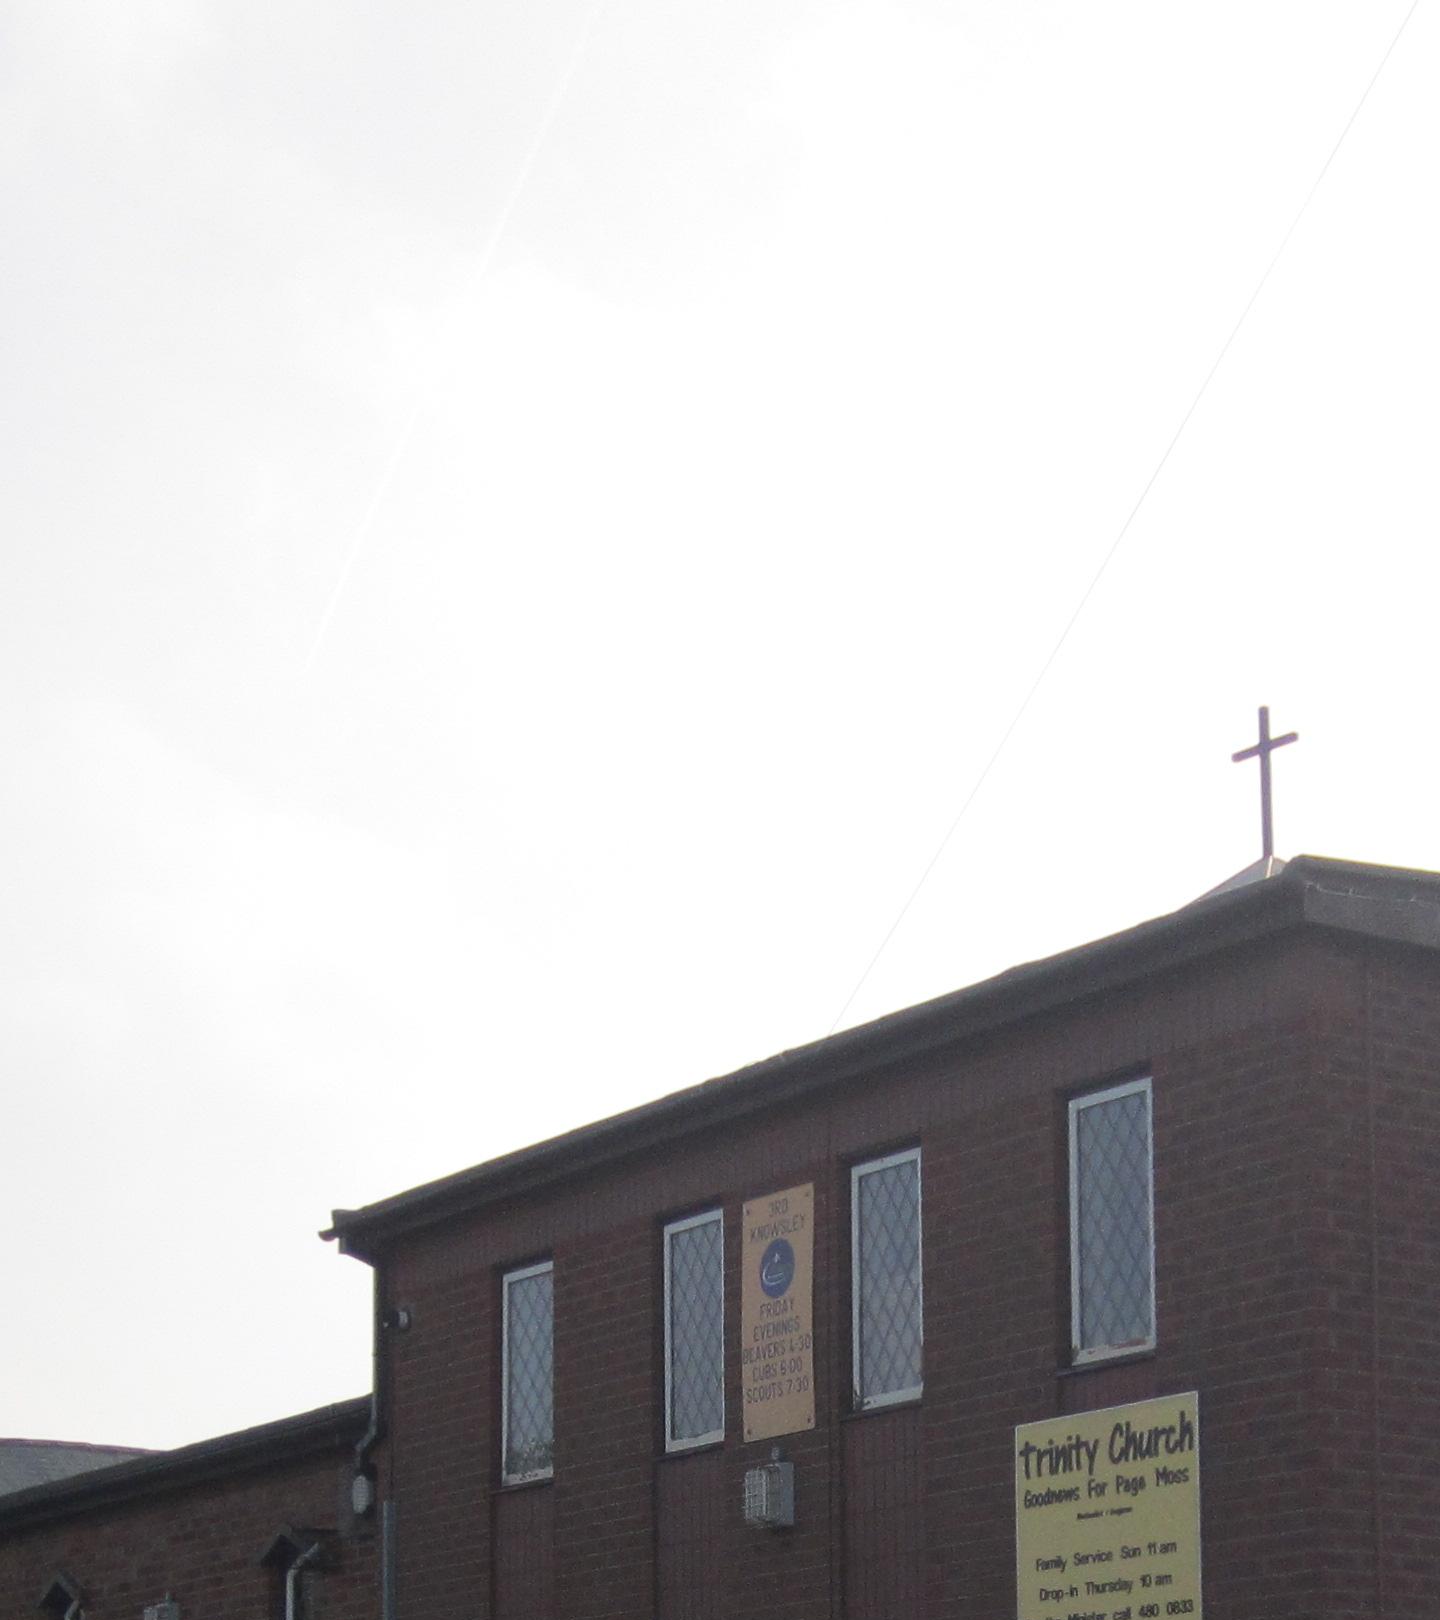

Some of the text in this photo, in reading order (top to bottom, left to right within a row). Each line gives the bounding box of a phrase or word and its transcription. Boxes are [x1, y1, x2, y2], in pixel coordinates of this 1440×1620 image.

[750, 1214, 805, 1242] KNOWSLEY
[760, 1298, 795, 1319] FRIDAY
[753, 1315, 800, 1342] EVENINGS
[743, 1339, 786, 1364] BEAVERS
[752, 1362, 778, 1383] CUBS
[746, 1381, 784, 1404] SCOUTS
[1109, 1410, 1194, 1465] Church
[1024, 1465, 1190, 1509] Goodnews For Page Moss
[1036, 1555, 1067, 1573] Family
[1073, 1549, 1113, 1566] Service
[1085, 1577, 1134, 1595] Thursday
[1138, 1602, 1160, 1618] 480
